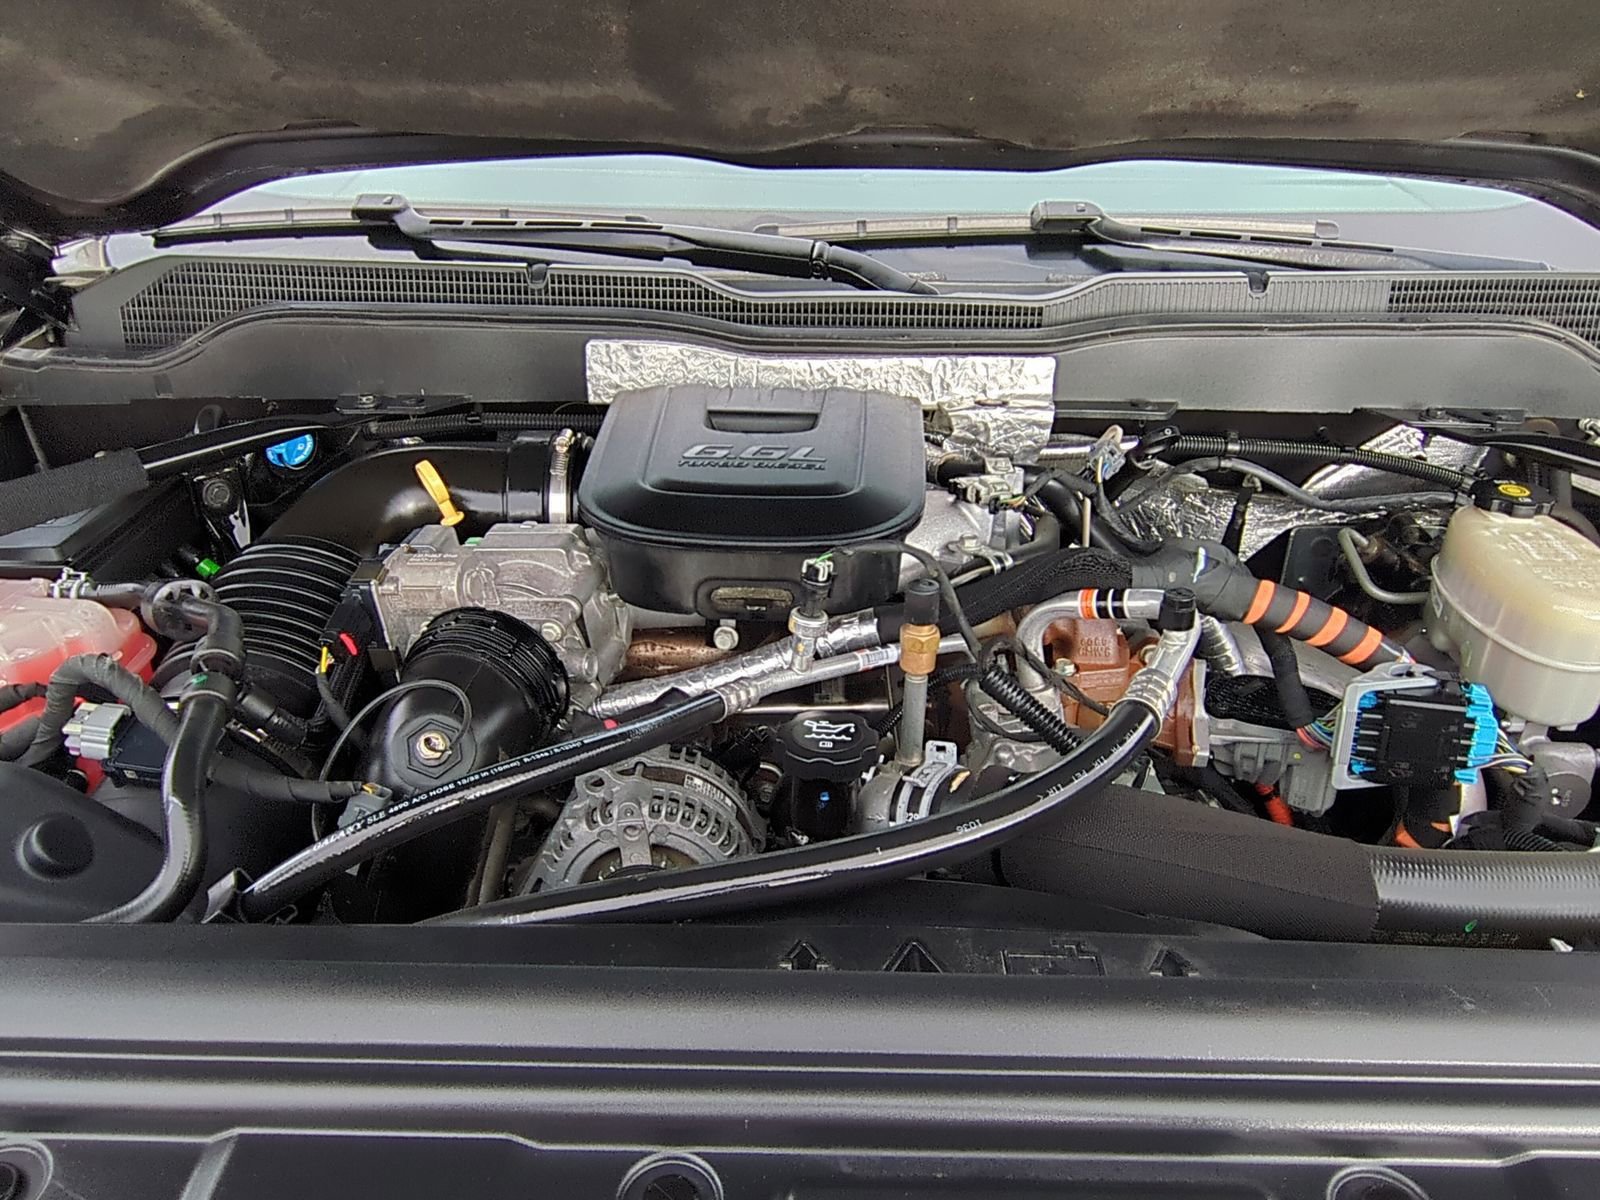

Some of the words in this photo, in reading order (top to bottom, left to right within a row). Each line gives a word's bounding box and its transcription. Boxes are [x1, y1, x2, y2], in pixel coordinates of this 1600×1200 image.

[682, 444, 826, 462] 6.6L
[1071, 769, 1088, 783] PET
[367, 811, 386, 824] SLE
[429, 783, 456, 799] HOSE
[956, 819, 982, 834] 1036
